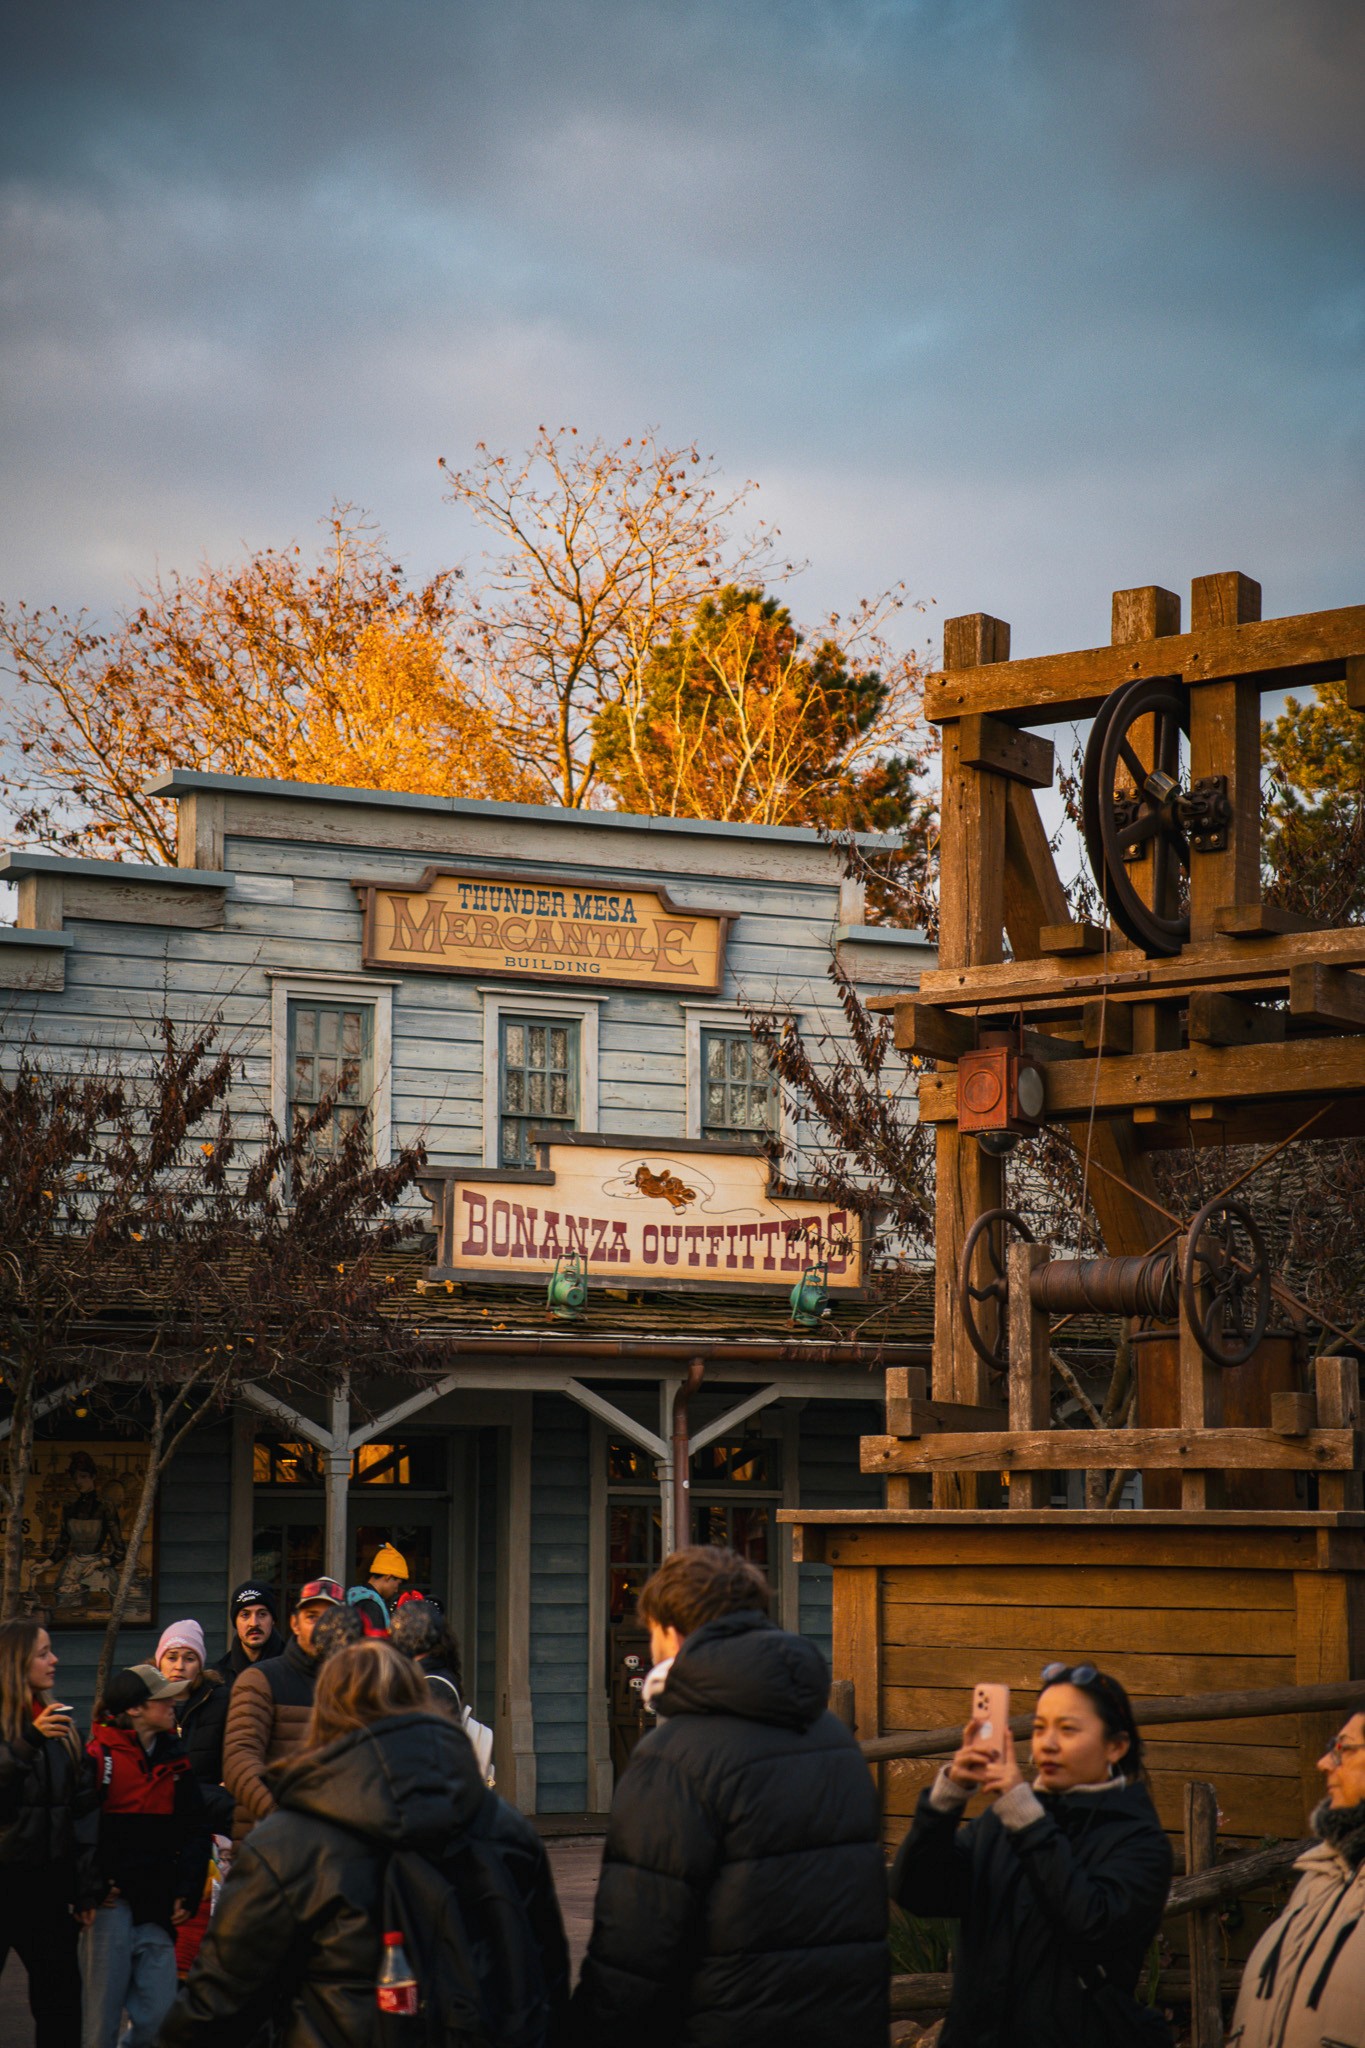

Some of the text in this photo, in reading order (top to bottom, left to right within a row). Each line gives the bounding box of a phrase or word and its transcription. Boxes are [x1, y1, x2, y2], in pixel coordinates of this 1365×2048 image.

[457, 883, 638, 924] THUNDER MESA
[387, 895, 699, 975] MERCANTILE
[504, 956, 601, 974] BUILDING
[461, 1189, 847, 1275] BONANZA OUTFITTERS
